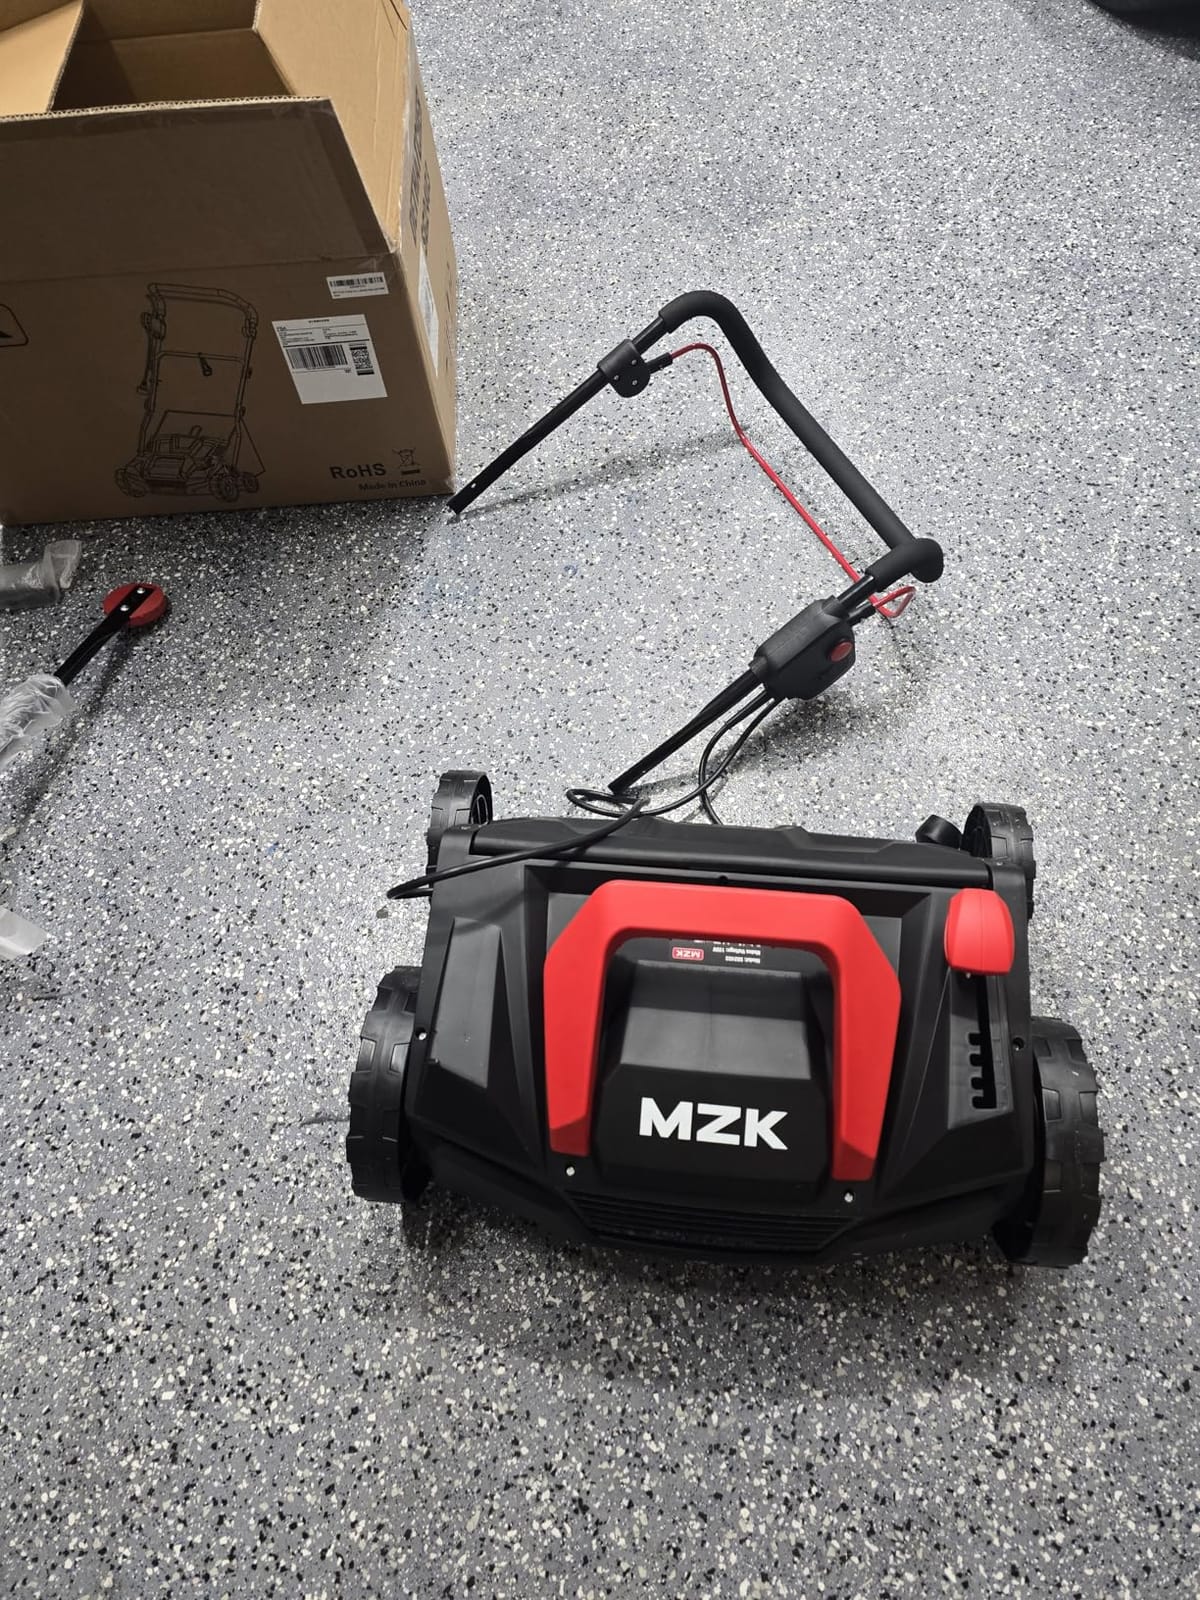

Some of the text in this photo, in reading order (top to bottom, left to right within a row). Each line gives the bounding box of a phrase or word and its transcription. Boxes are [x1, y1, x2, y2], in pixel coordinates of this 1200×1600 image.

[329, 463, 387, 479] RoHS
[358, 479, 427, 491] Made in China
[675, 949, 701, 959] MZK
[638, 1096, 789, 1151] MZK
